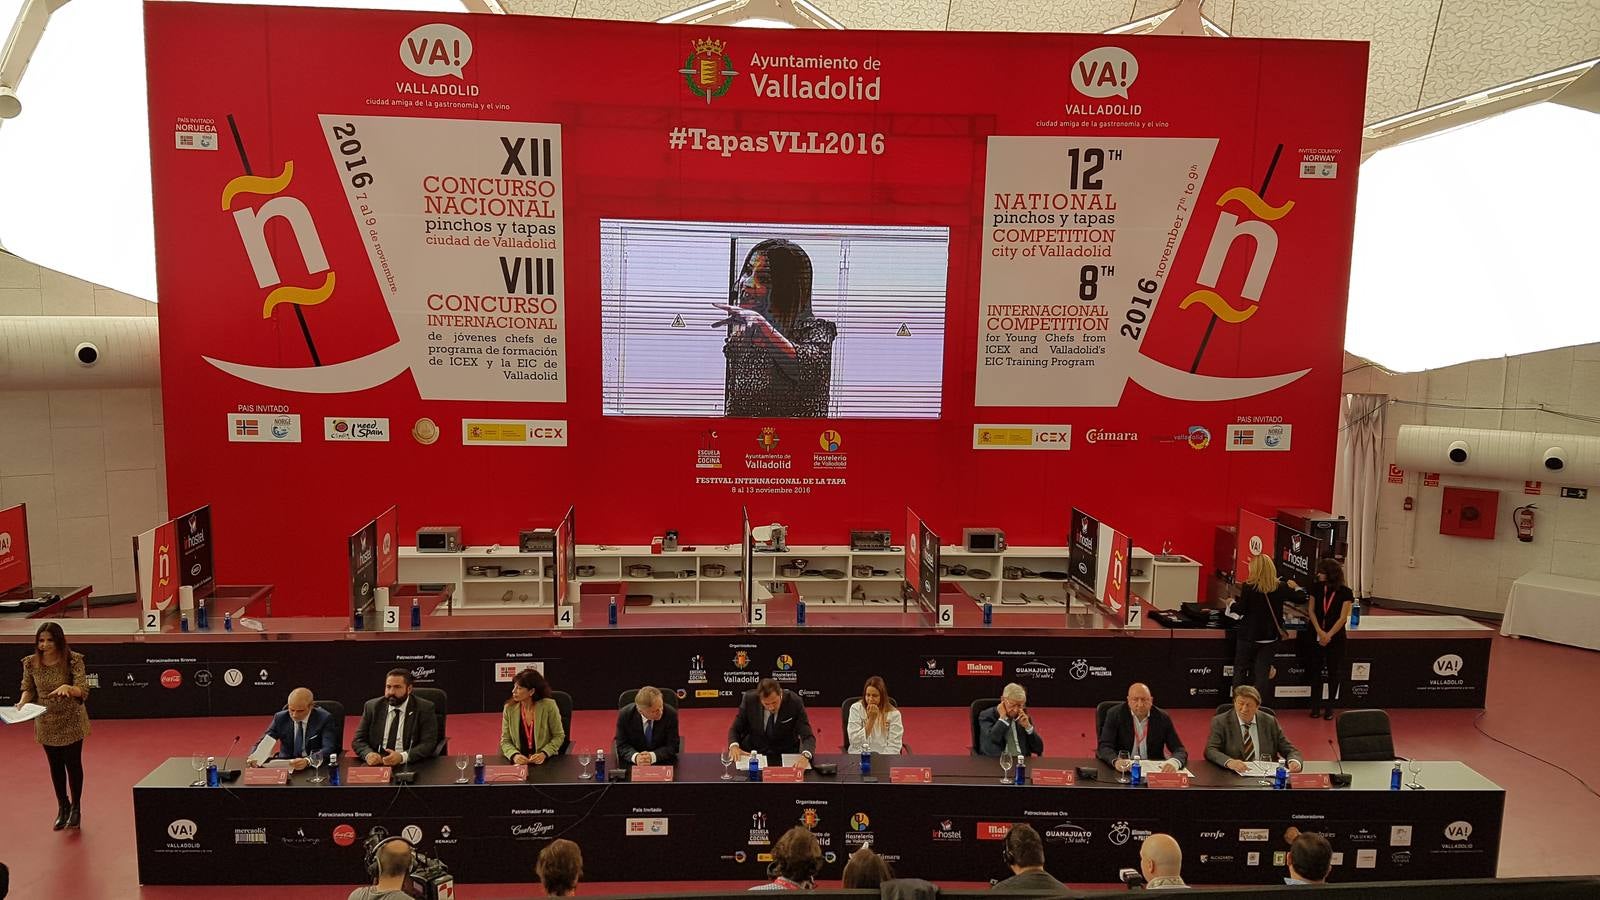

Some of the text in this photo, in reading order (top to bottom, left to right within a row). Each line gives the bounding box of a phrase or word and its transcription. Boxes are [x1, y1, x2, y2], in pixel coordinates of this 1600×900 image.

[408, 37, 461, 66] VA!
[750, 52, 881, 71] Ayuntamiento de
[1079, 61, 1127, 87] VA!
[396, 82, 479, 96] VALLADOLID
[750, 73, 881, 101] Valladolid
[366, 98, 390, 106] ciudad
[392, 99, 413, 109] amiga
[1065, 104, 1142, 116] VALLADOLID
[176, 124, 217, 132] NORUEGA
[1060, 120, 1080, 128] amiga
[669, 127, 885, 158] #TapasVLL2016
[500, 136, 552, 177] XII
[423, 175, 556, 198] CONCURSO
[332, 122, 398, 295] 2016 7 al 9 de noviembre.
[424, 196, 556, 218] NACIONAL
[993, 194, 1116, 210] NATIONAL
[992, 211, 1115, 228] pinchos y tapas
[425, 217, 556, 238] pinchos y tapas
[426, 235, 557, 250] ciudad de Valladolid
[992, 229, 1116, 243] COMPETITION
[992, 244, 1112, 260] city of Valladolid
[1120, 278, 1158, 341] 2016
[1156, 216, 1184, 278] november
[1184, 184, 1195, 196] to
[499, 256, 554, 295] VIII
[427, 294, 558, 314] CONCURSO
[987, 304, 1109, 318] INTERNACIONAL
[427, 314, 558, 330] INTERNACIONAL
[986, 317, 1110, 330] COMPETITION
[428, 332, 558, 344] de jóvenes chefs de
[986, 333, 1106, 345] for Young Chefs from
[428, 346, 558, 357] programa de formación
[985, 345, 1106, 354] ICEX and Valladolid's
[429, 357, 558, 369] de ICEX y la EIC de
[984, 357, 1096, 368] EIC Training Program
[504, 370, 558, 381] Valladolid
[356, 420, 377, 430] need
[358, 428, 383, 438] Spain
[1086, 428, 1138, 444] Cámara
[746, 460, 792, 469] Valladolid
[146, 614, 156, 628] 2
[386, 610, 396, 624] 3
[560, 610, 570, 622] 4
[754, 608, 762, 621] 5
[942, 609, 950, 622] 6
[1130, 610, 1138, 622] 7
[1190, 667, 1212, 676] renfe
[1437, 660, 1458, 671] VA!
[171, 825, 192, 836] VA!
[1200, 830, 1225, 840] renfe
[1448, 826, 1468, 836] VA!
